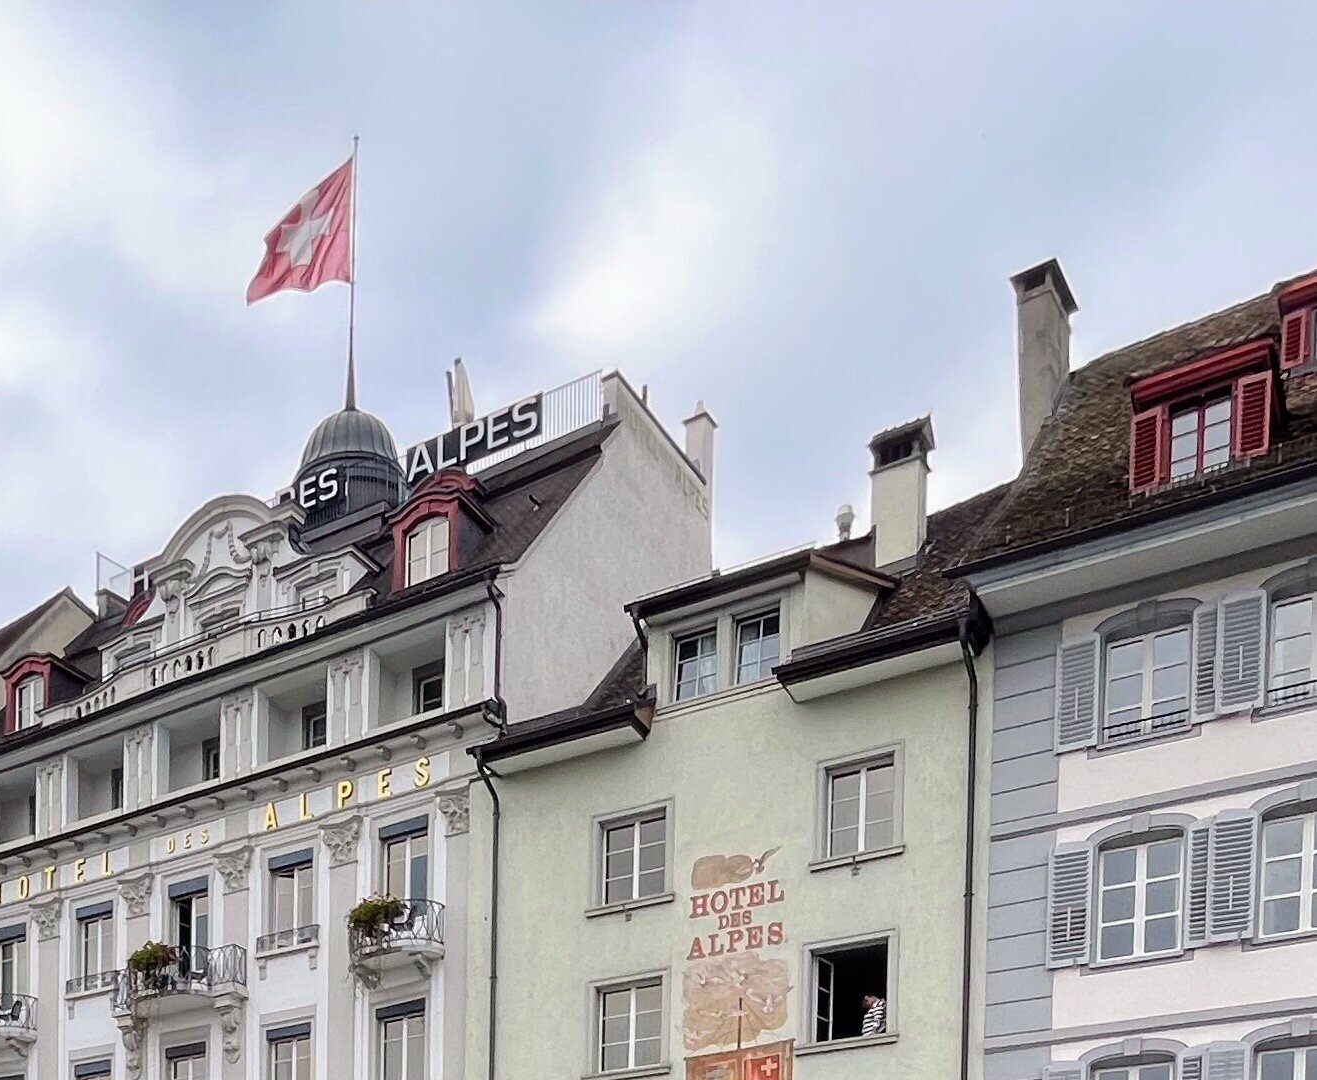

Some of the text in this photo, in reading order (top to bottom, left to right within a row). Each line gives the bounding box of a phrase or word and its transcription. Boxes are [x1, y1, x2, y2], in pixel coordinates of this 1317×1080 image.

[408, 397, 539, 483] ALPES
[166, 828, 212, 855] DES
[263, 756, 432, 831] ALPES
[688, 880, 785, 919] HOTEL
[718, 910, 752, 930] DES
[686, 922, 783, 961] ALPES
